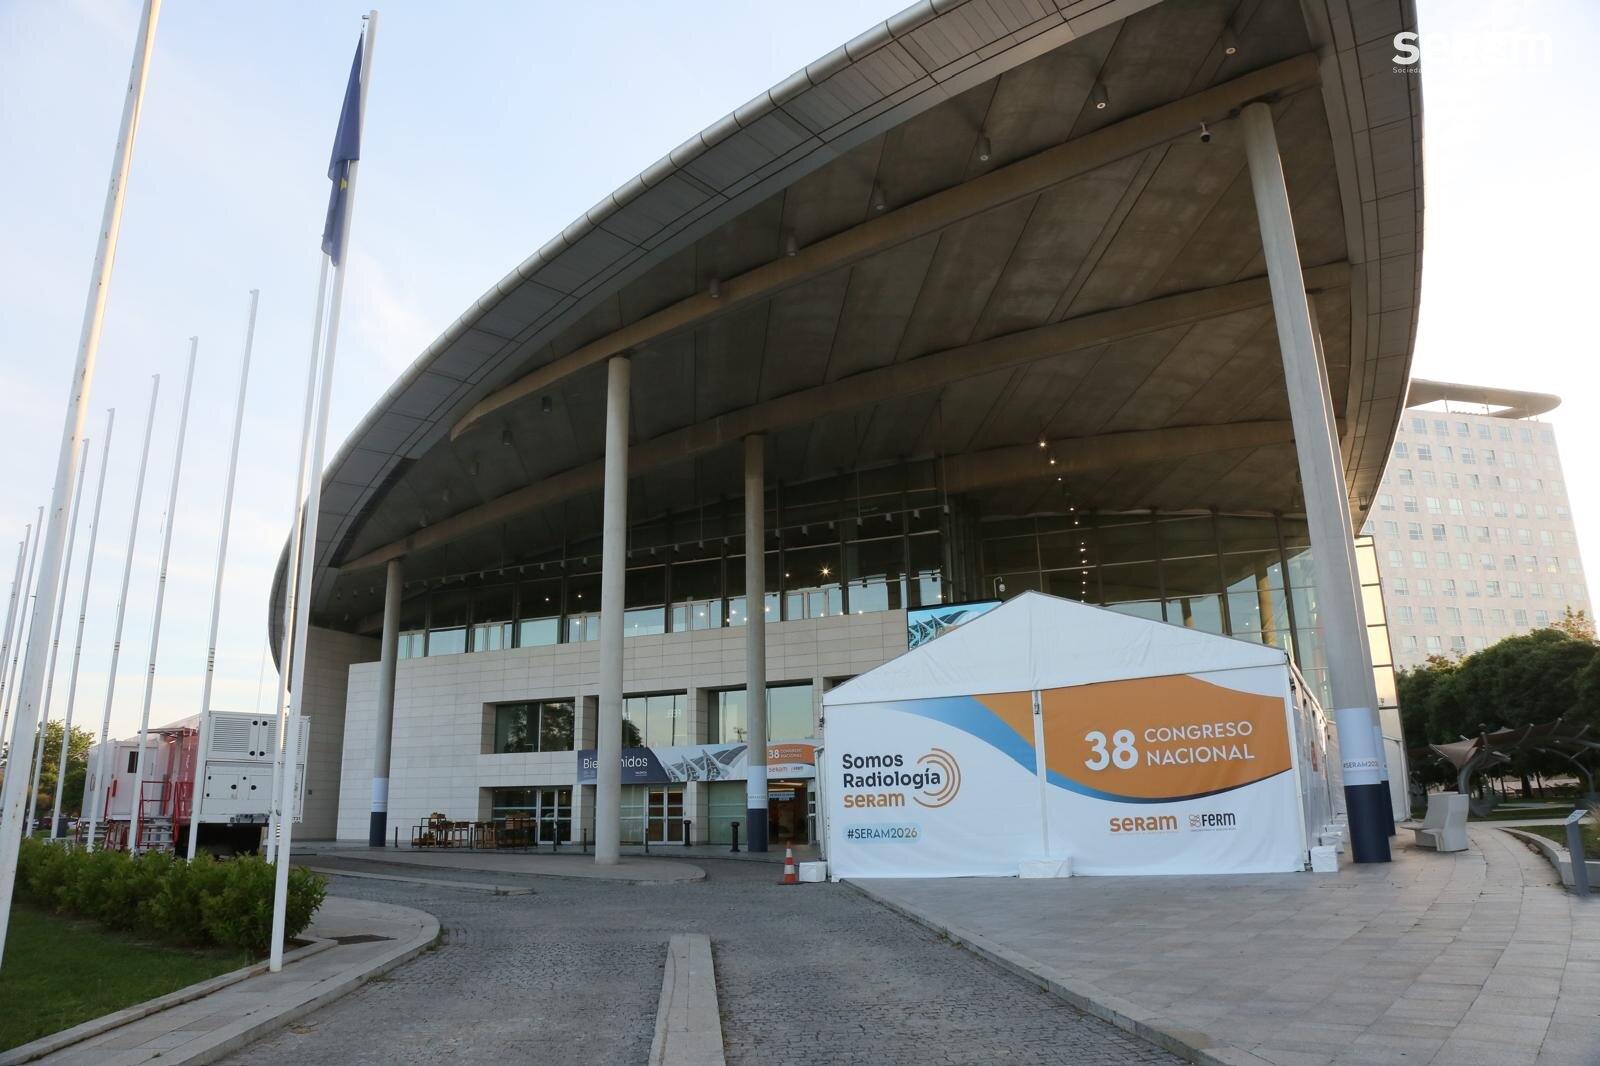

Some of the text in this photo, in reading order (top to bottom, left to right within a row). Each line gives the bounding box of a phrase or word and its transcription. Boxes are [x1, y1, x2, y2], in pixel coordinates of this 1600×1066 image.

[1144, 721, 1253, 743] CONGRESO
[1084, 729, 1139, 771] 38
[1146, 744, 1255, 766] NACIONAL
[842, 753, 904, 769] Somos
[843, 768, 941, 789] Radiología
[847, 827, 918, 839] #SERAM2026
